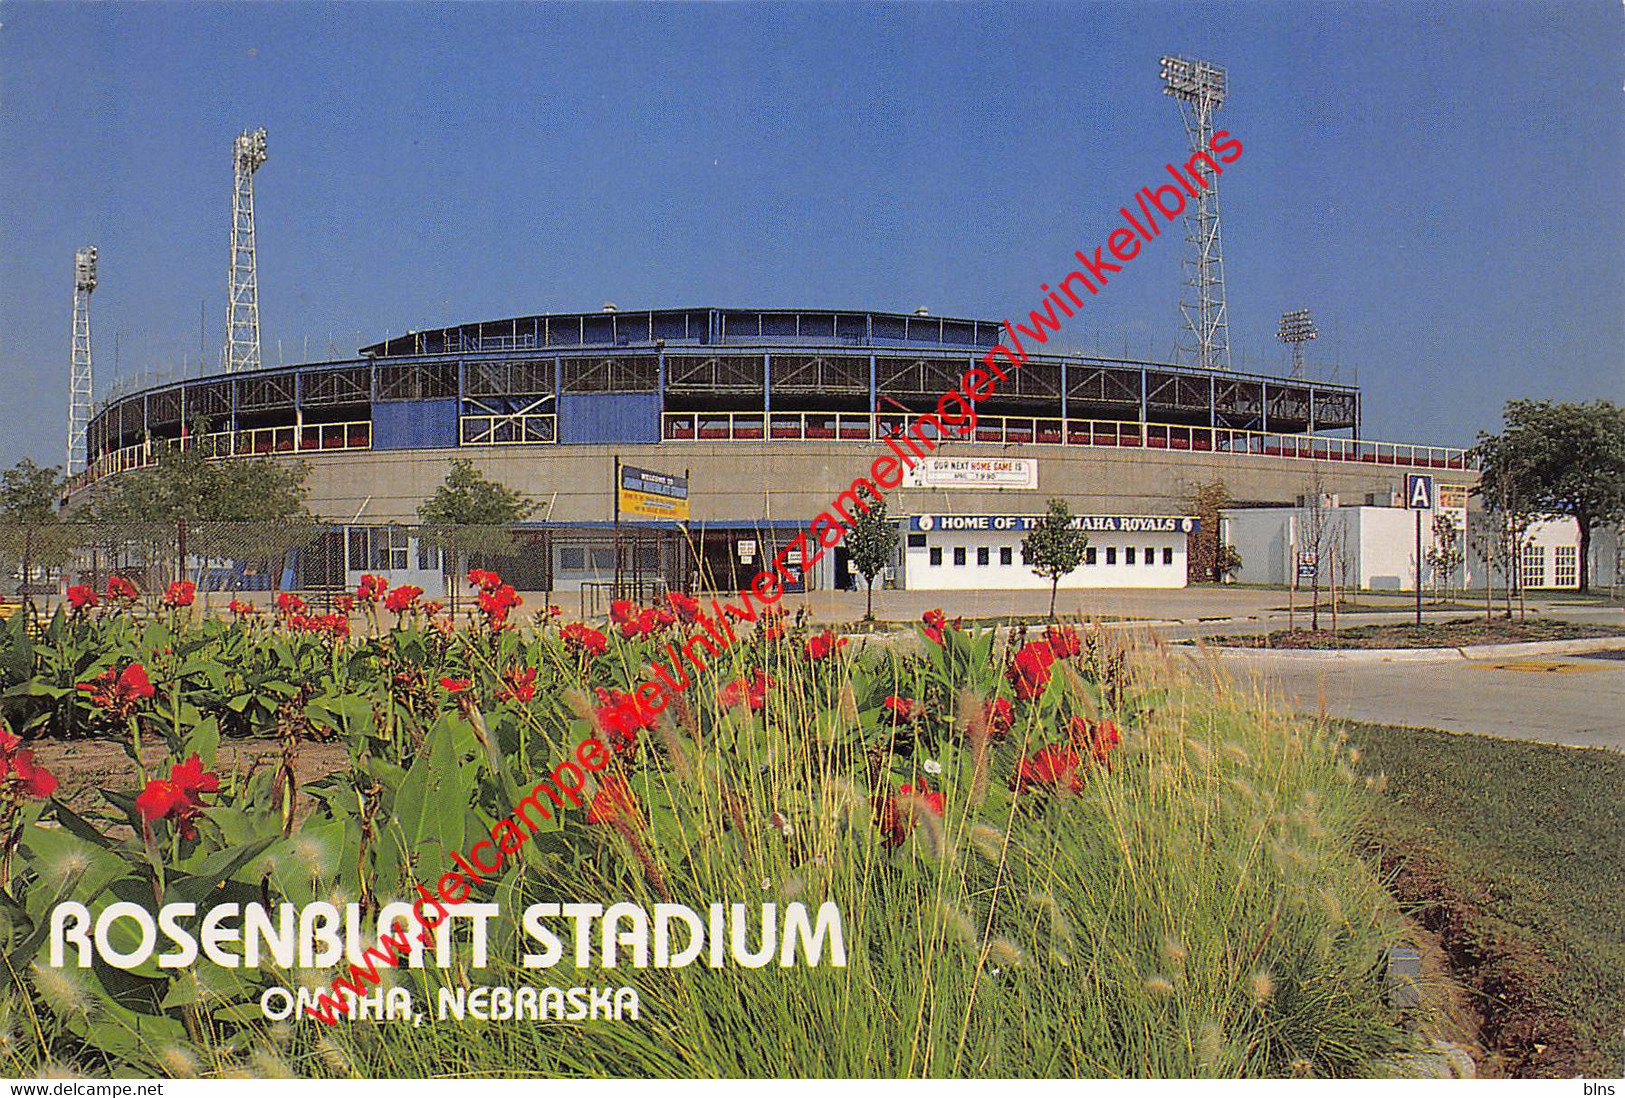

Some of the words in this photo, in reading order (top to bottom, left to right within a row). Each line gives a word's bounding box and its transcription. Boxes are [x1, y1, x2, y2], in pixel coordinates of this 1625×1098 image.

[933, 461, 948, 470] OUR
[951, 461, 969, 470] NEXT
[971, 462, 991, 471] HOME
[993, 462, 1013, 471] GAME
[1014, 463, 1022, 471] IS
[641, 473, 667, 485] WELCOME
[1410, 477, 1430, 507] A
[941, 516, 989, 529] HOME
[994, 516, 1017, 529] OF
[1063, 516, 1117, 531] MAHA
[1119, 516, 1176, 532] ROYALS
